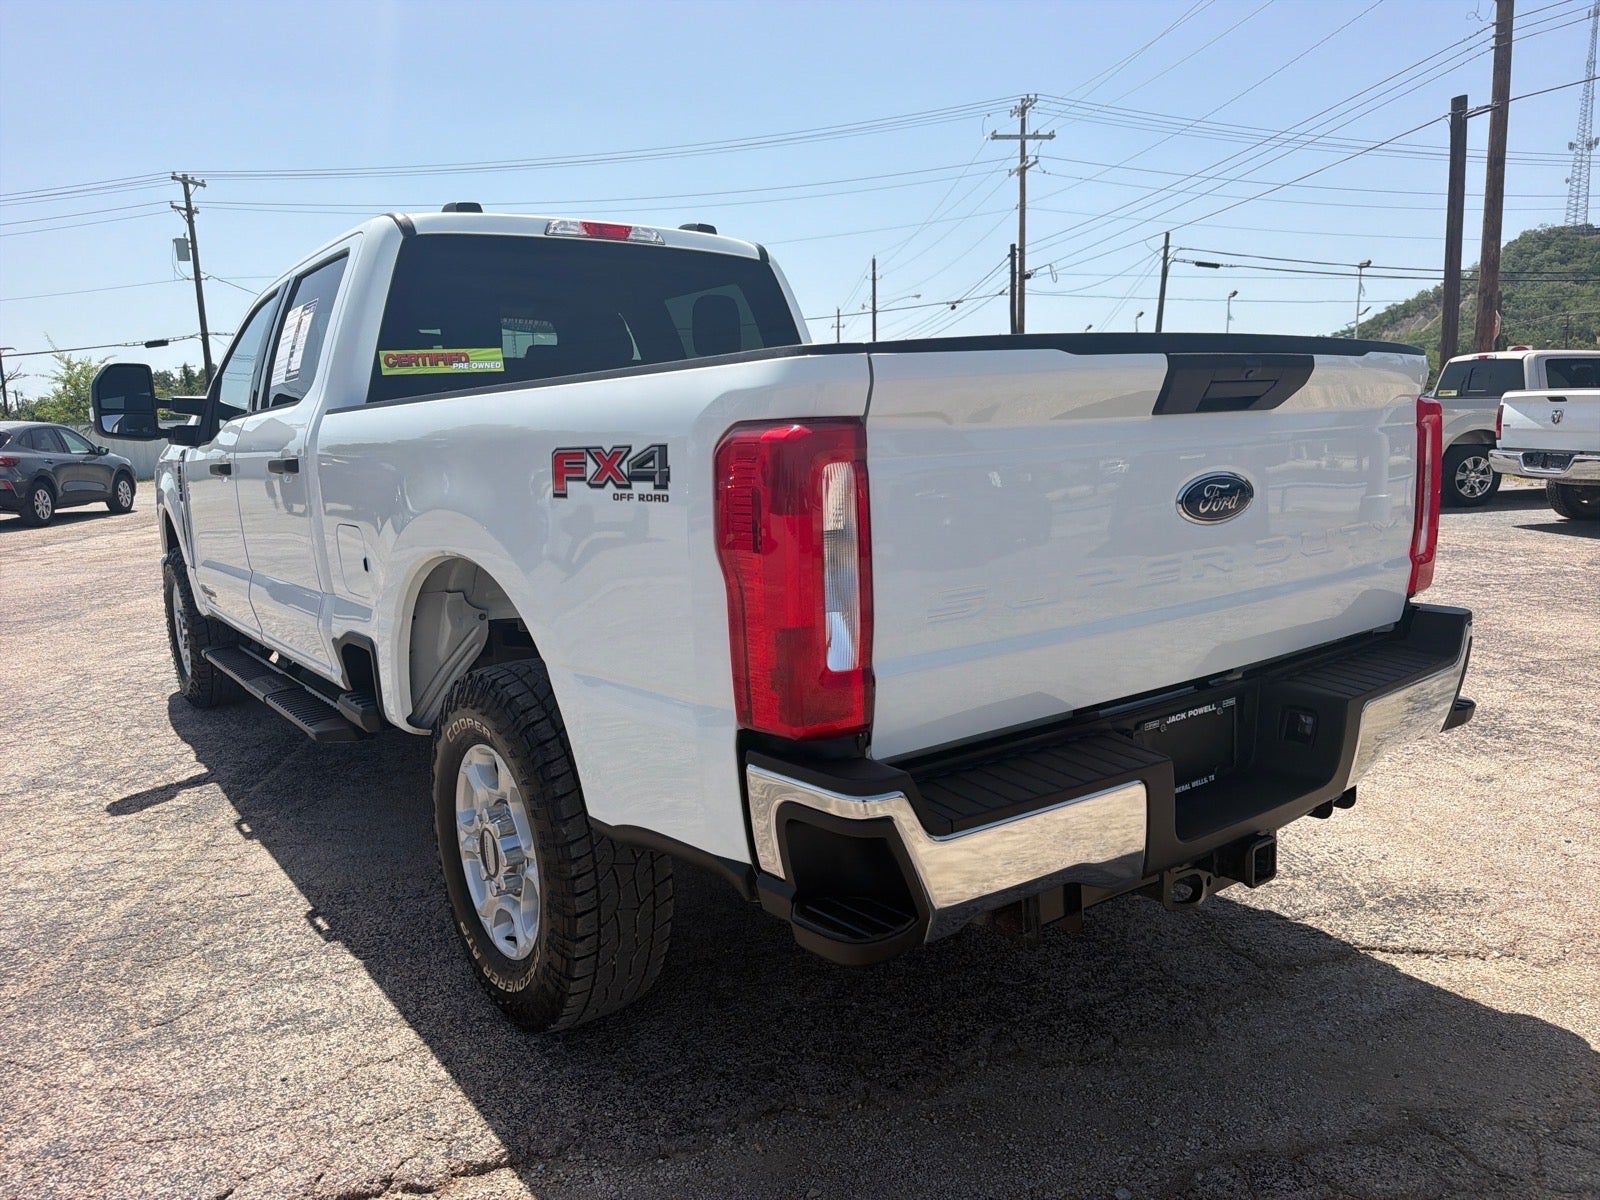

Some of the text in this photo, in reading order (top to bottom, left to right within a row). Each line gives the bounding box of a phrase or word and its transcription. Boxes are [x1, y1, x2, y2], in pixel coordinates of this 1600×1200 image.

[383, 352, 470, 368] CERTIFIED
[552, 443, 671, 499] FX4
[612, 493, 669, 503] OFF ROAD
[1199, 483, 1240, 514] Ford
[1166, 704, 1216, 724] JACK POWELL
[446, 717, 492, 744] COOPER
[1174, 783, 1191, 794] NERAL
[482, 945, 541, 993] DISCOVERER
